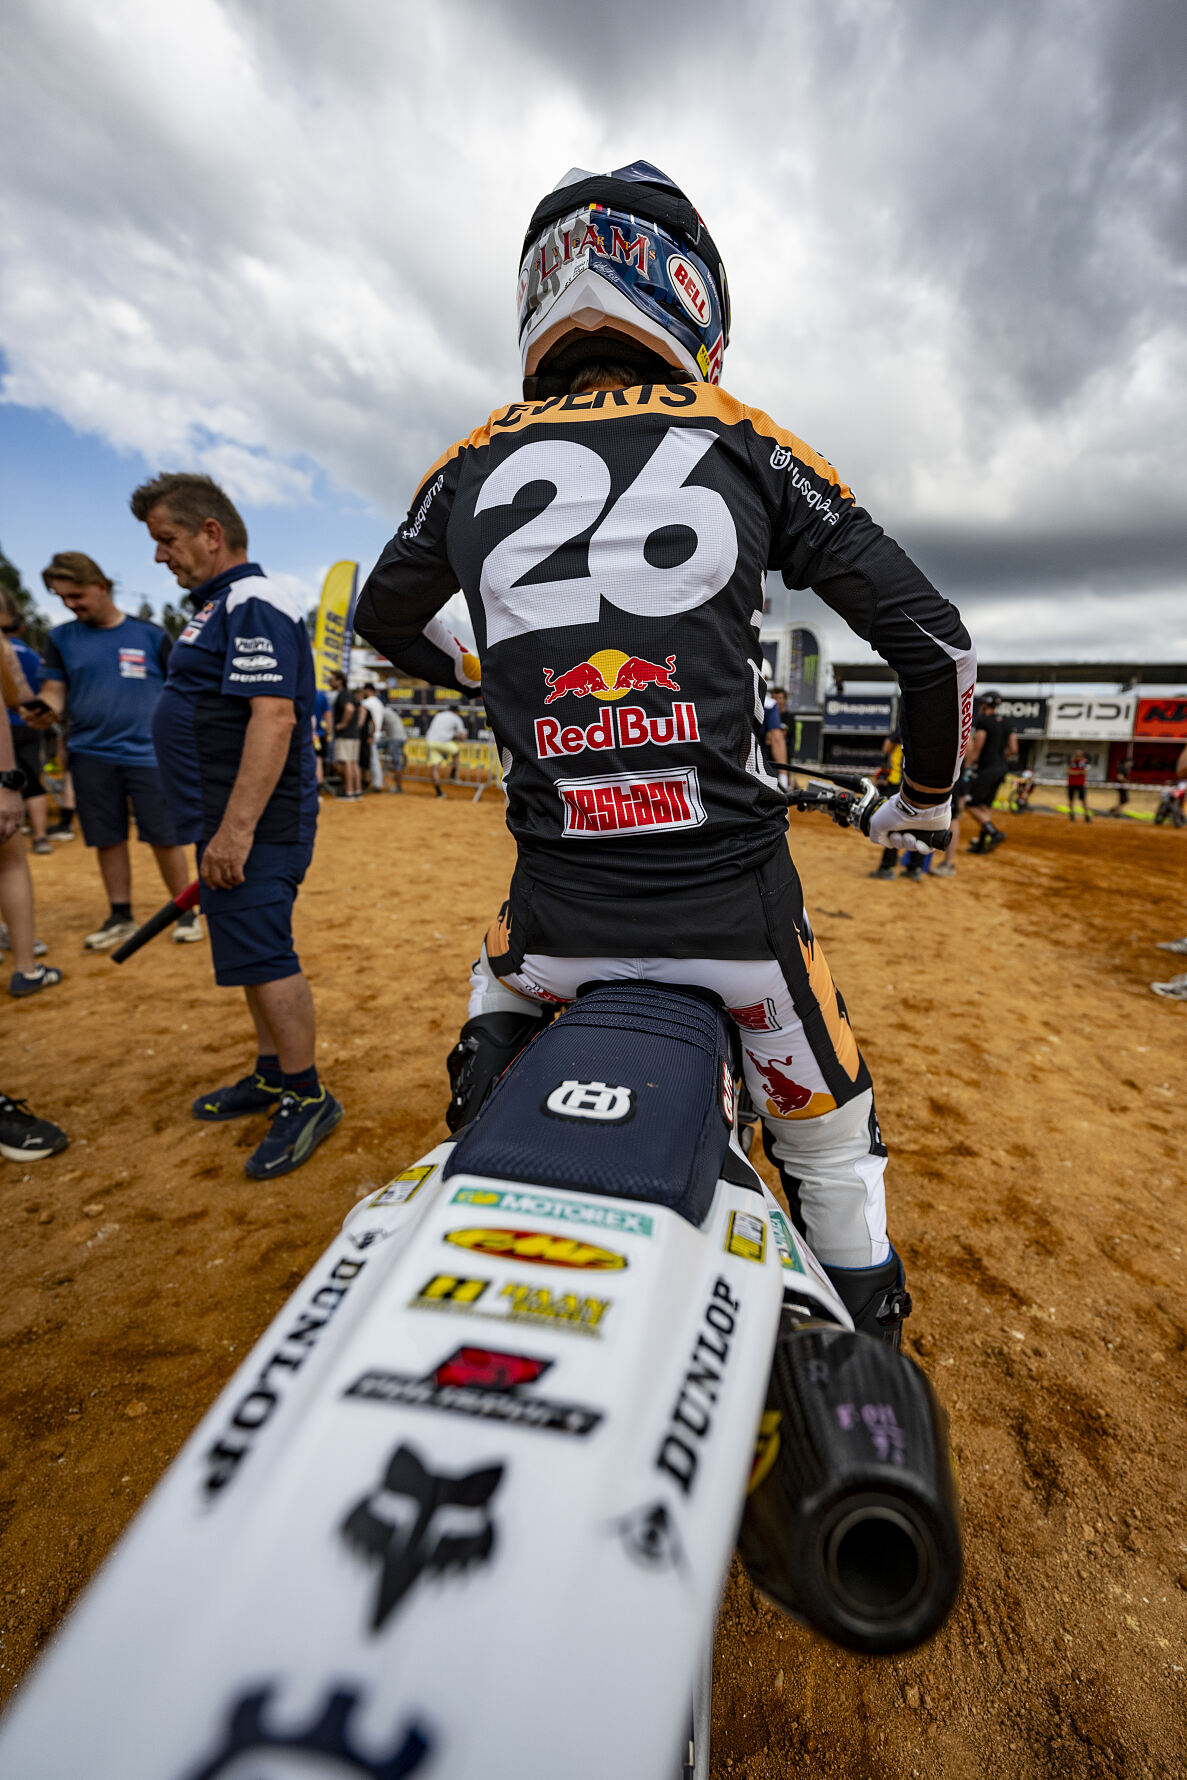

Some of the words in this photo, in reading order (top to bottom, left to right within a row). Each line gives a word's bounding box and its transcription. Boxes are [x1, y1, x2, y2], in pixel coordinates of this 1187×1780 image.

[540, 224, 650, 281] LIAM
[673, 262, 706, 319] BELL
[787, 461, 840, 526] Husqvaa
[474, 427, 738, 649] 26
[534, 706, 615, 759] Red
[616, 702, 700, 748] Bull
[1057, 703, 1131, 720] SIDI
[502, 1193, 643, 1232] MOTOREX
[205, 1257, 367, 1492] DUNLOP
[656, 1277, 740, 1496] DUNLOP
